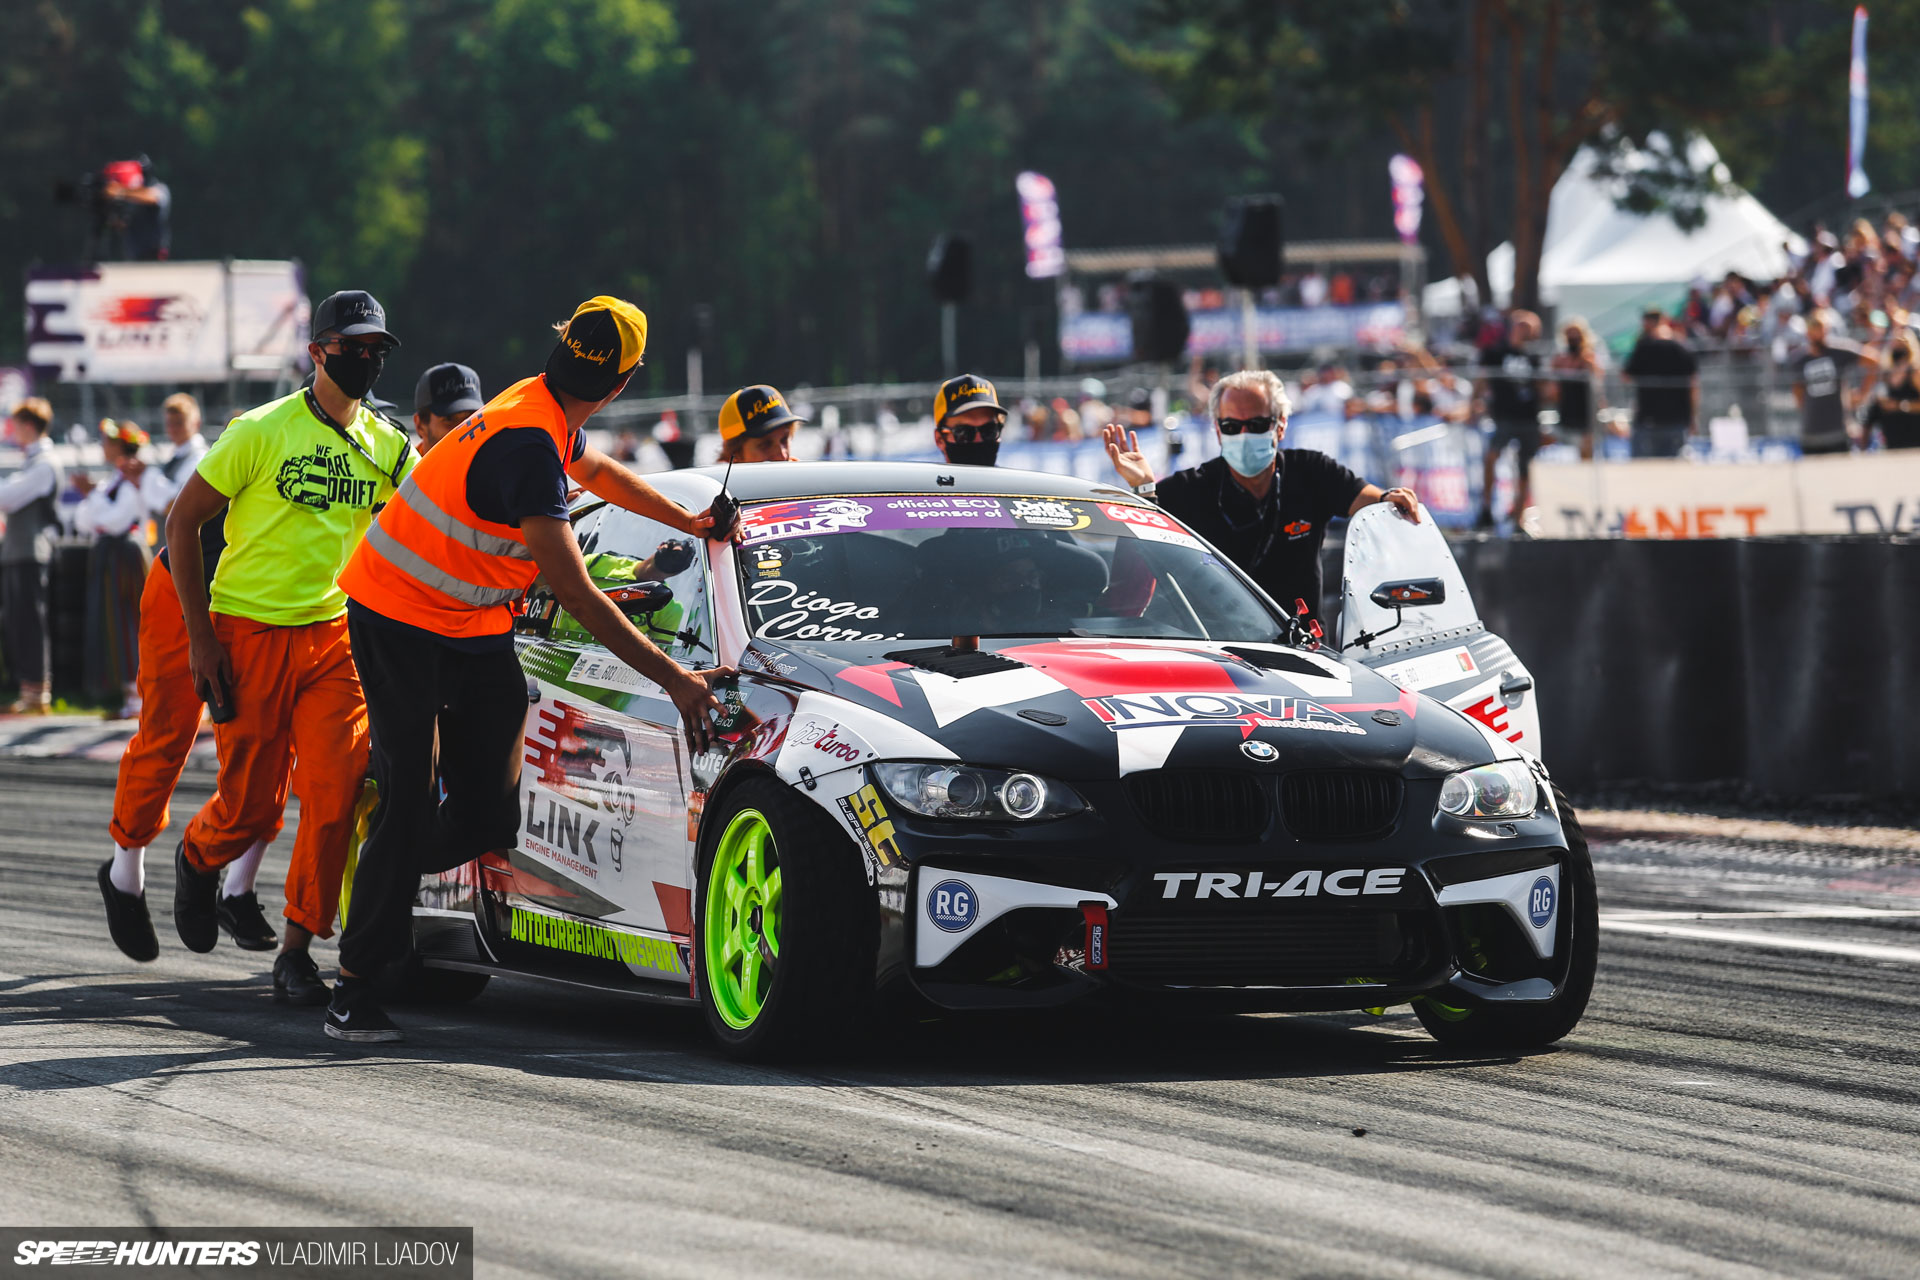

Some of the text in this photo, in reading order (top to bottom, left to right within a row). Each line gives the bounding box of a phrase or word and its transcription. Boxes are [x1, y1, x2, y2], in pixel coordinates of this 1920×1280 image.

[315, 443, 332, 457] WE
[327, 452, 354, 477] ARE
[327, 477, 377, 506] DRIFT
[886, 499, 1000, 509] official ECU
[905, 508, 1003, 520] sponsor of
[1107, 506, 1169, 528] 603
[743, 517, 833, 540] LINK
[752, 548, 782, 561] TS
[748, 579, 880, 623] Diogo
[724, 690, 748, 701] centro
[1081, 695, 1359, 727] INOVA
[526, 790, 600, 865] LINK
[525, 838, 598, 880] ENGINE MANAGEMENT
[1153, 868, 1407, 899] TRI-ACE
[936, 890, 969, 916] RG
[1532, 887, 1551, 912] RG
